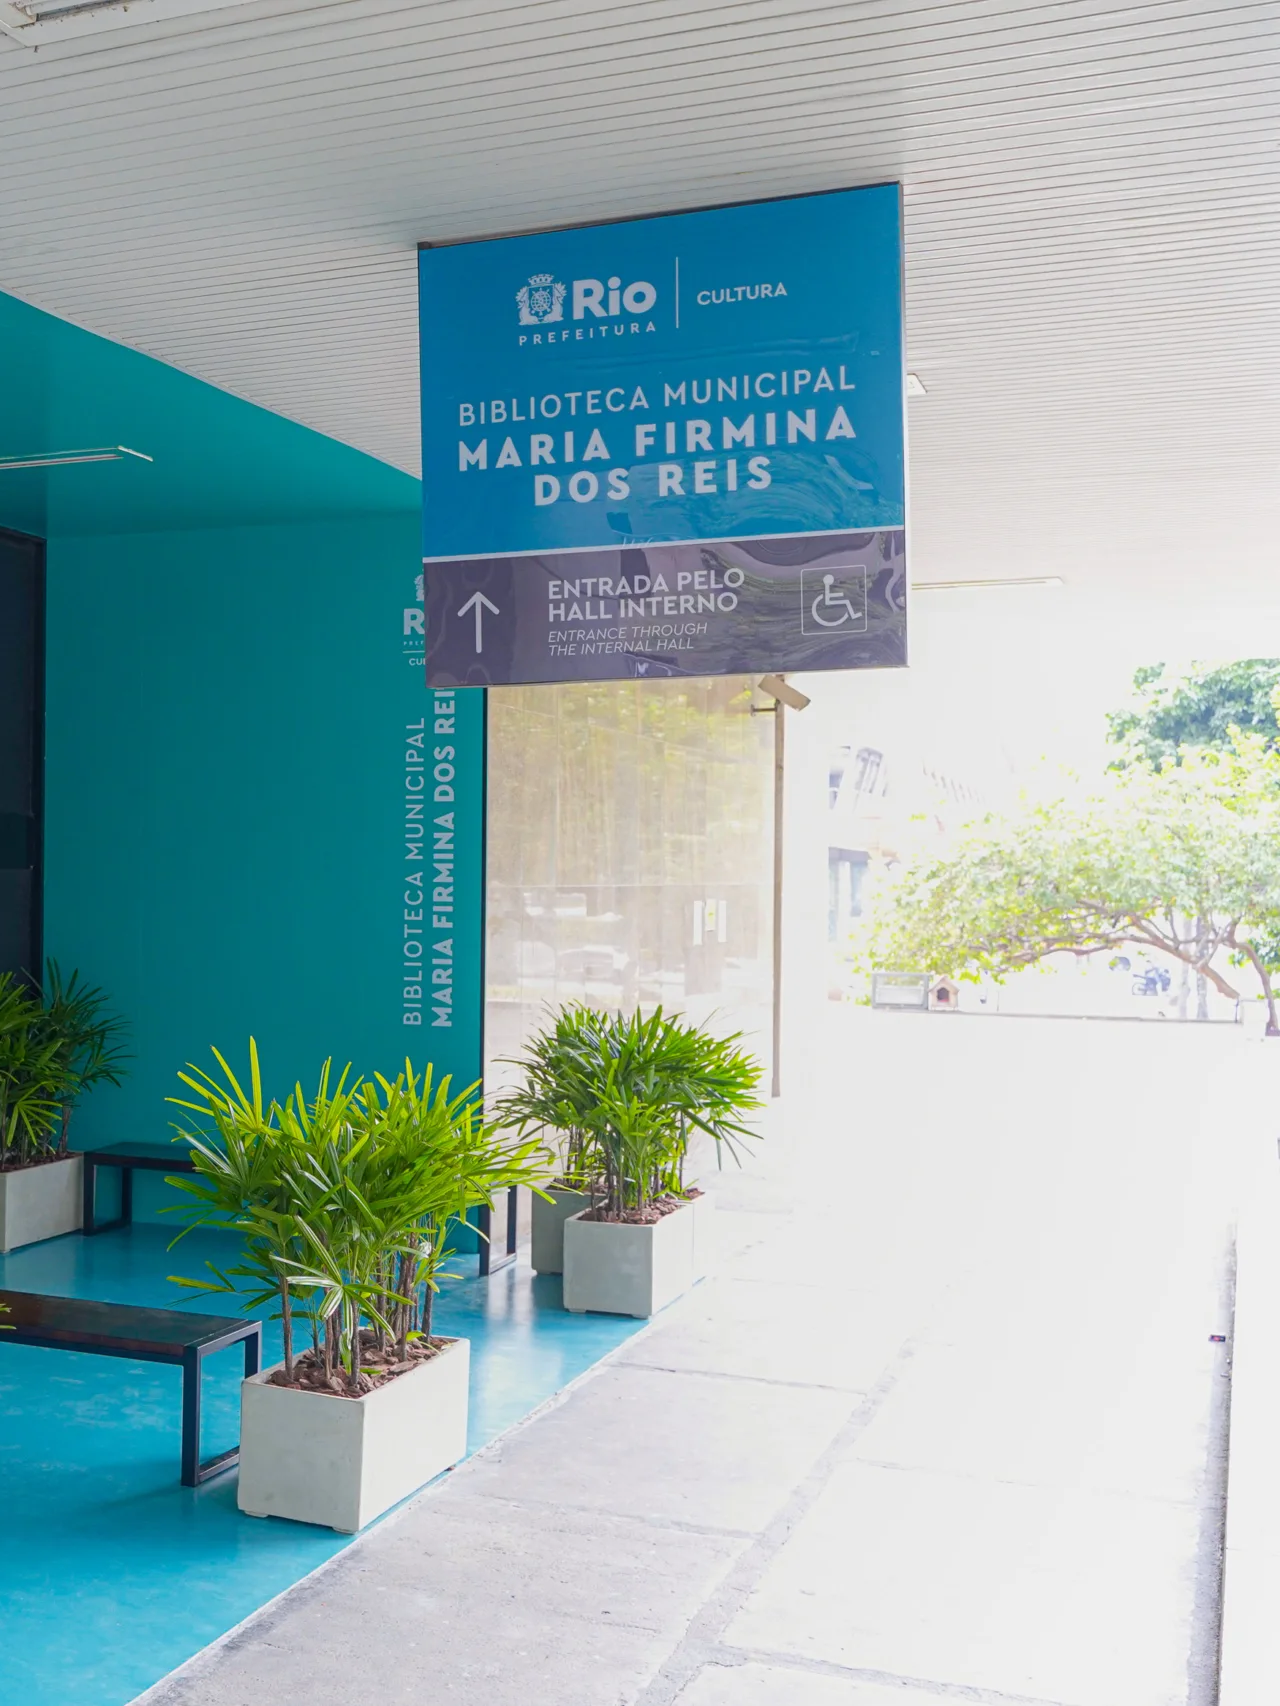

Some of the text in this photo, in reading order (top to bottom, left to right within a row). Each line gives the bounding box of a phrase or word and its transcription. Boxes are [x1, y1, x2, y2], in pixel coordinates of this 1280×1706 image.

[573, 277, 656, 319] Rio
[697, 283, 787, 305] CULTURA
[519, 322, 655, 345] PREFEITURA
[460, 366, 855, 426] BIBLIOTECA MUNICIPAL
[459, 406, 856, 471] MARIA FIRMINA
[534, 456, 772, 506] DOS REIS
[549, 568, 744, 600] ENTRADA PELO
[549, 592, 738, 622] HALL INTERNO
[548, 622, 708, 643] ENTRANCE THROUGH
[549, 637, 694, 657] THE INTERNAL HALL
[403, 718, 424, 1024] BIBLIOTECA MUNICIPAL
[432, 686, 455, 1026] MARIA FIRMINA DOS REI
